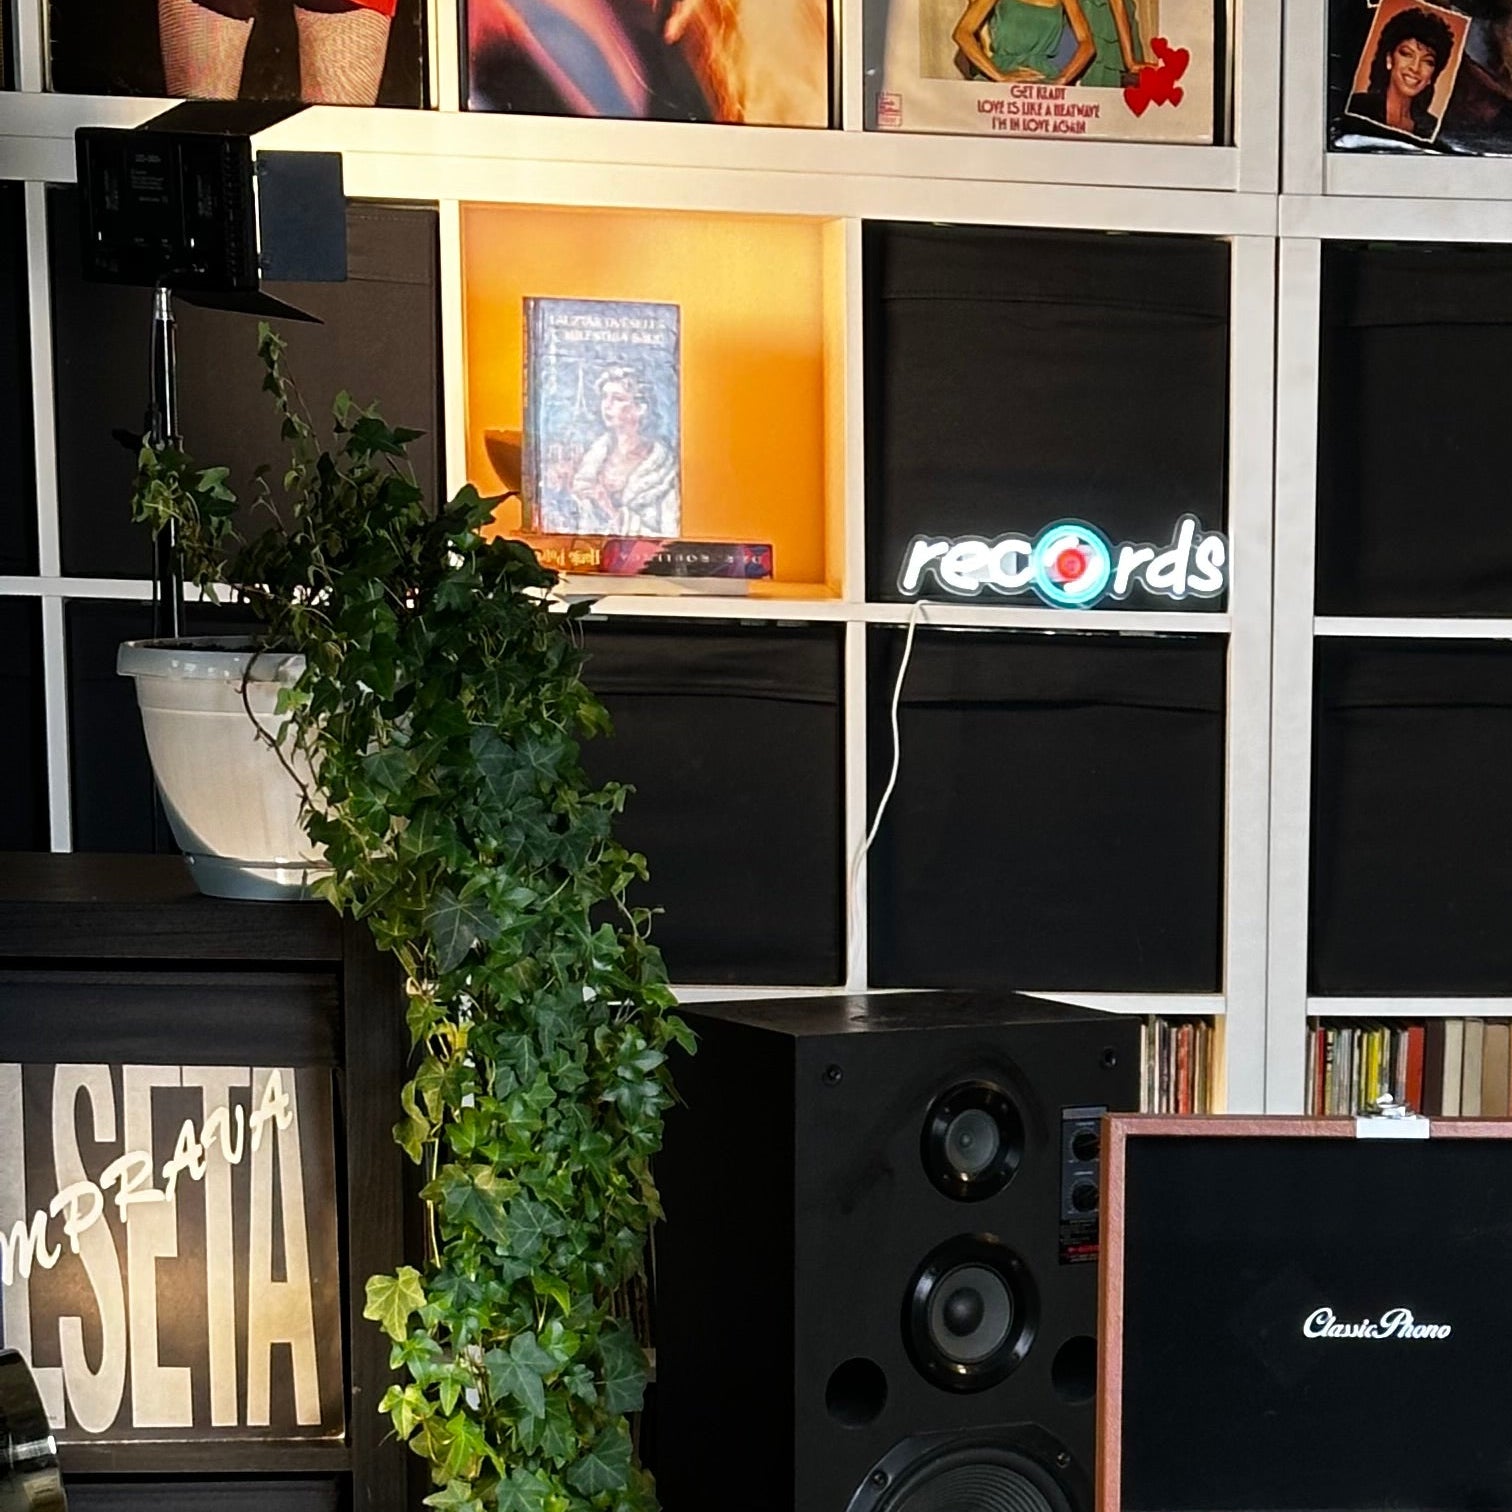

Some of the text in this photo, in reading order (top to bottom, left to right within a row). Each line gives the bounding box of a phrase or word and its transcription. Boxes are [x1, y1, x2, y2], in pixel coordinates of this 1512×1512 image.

[1010, 85, 1066, 101] GET READY
[977, 99, 1100, 118] LOVE IS LIKE A HEATWAVE
[992, 117, 1007, 130] I'M
[1010, 117, 1020, 131] IN
[1022, 118, 1050, 132] LOVE
[902, 518, 1226, 604] records
